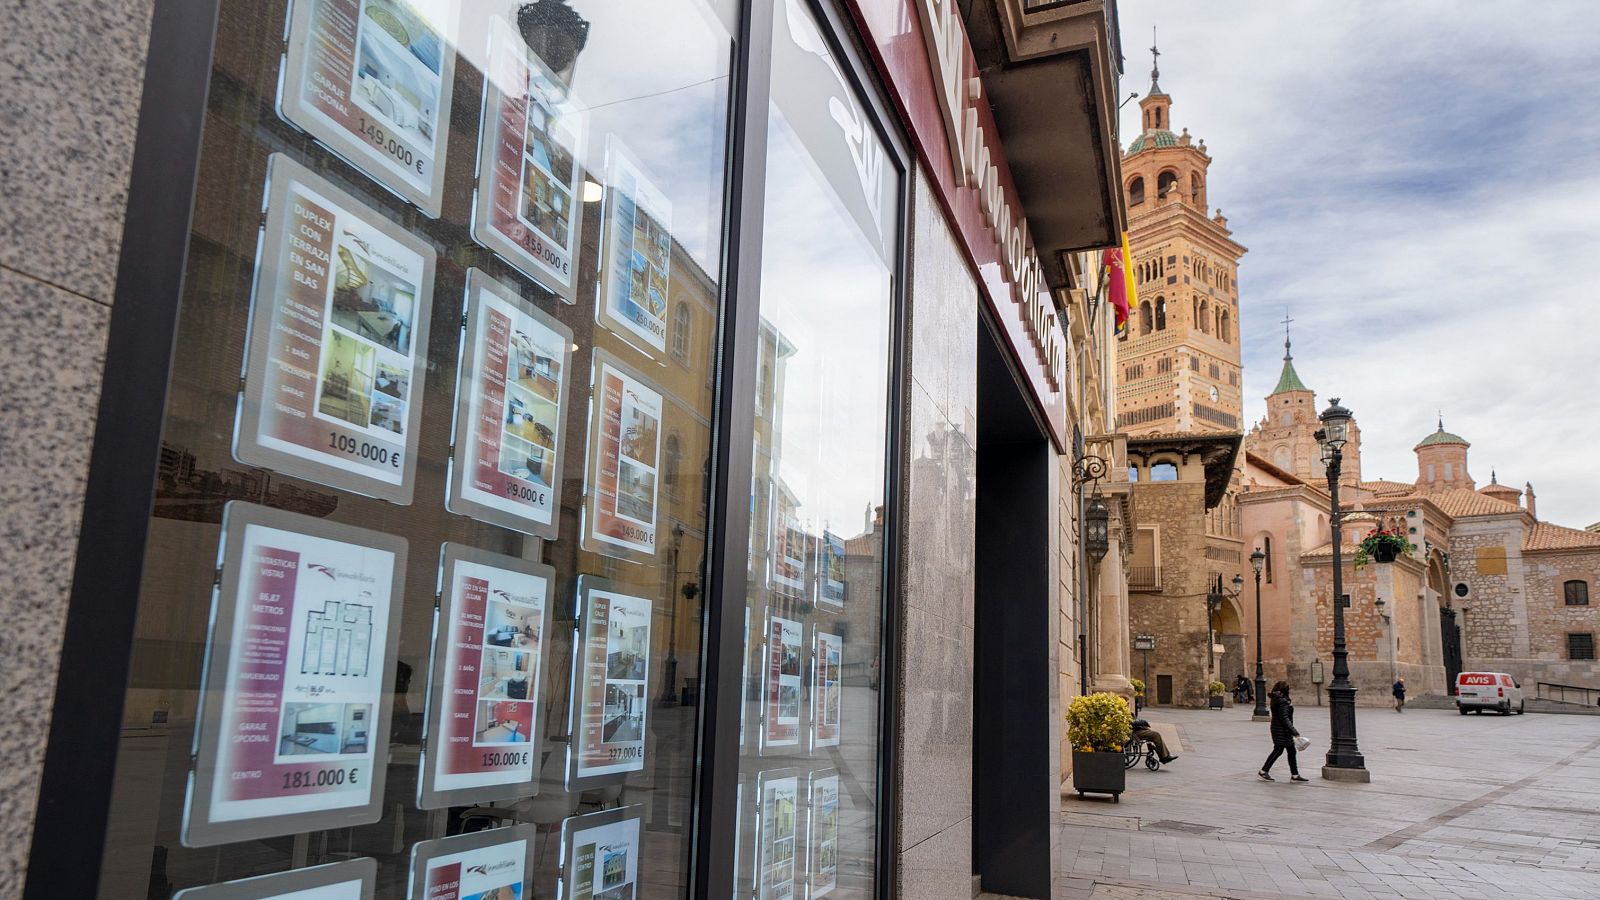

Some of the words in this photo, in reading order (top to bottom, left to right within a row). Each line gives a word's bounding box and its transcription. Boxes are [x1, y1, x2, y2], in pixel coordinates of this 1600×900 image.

[358, 117, 413, 166] 149.000
[415, 159, 424, 174] €
[294, 203, 331, 231] DUPLEX
[300, 224, 321, 242] CON
[288, 233, 330, 263] TERRAZA
[289, 251, 304, 266] EN
[304, 259, 325, 277] SAN
[562, 262, 568, 275] €
[294, 270, 318, 290] BLAS
[329, 432, 387, 464] 109.000
[391, 452, 400, 468] €
[539, 493, 545, 505] €
[649, 533, 654, 545] €
[252, 555, 296, 569] ANTASTICAS
[261, 568, 285, 578] VISTAS
[252, 603, 285, 615] METROS
[1466, 676, 1489, 684] AVIS
[240, 722, 268, 731] GARAJE
[482, 752, 521, 767] 150.000
[522, 751, 529, 765] €
[637, 746, 643, 758] €
[232, 770, 262, 780] CENTRO
[283, 767, 345, 790] 181.000
[348, 767, 358, 784] €
